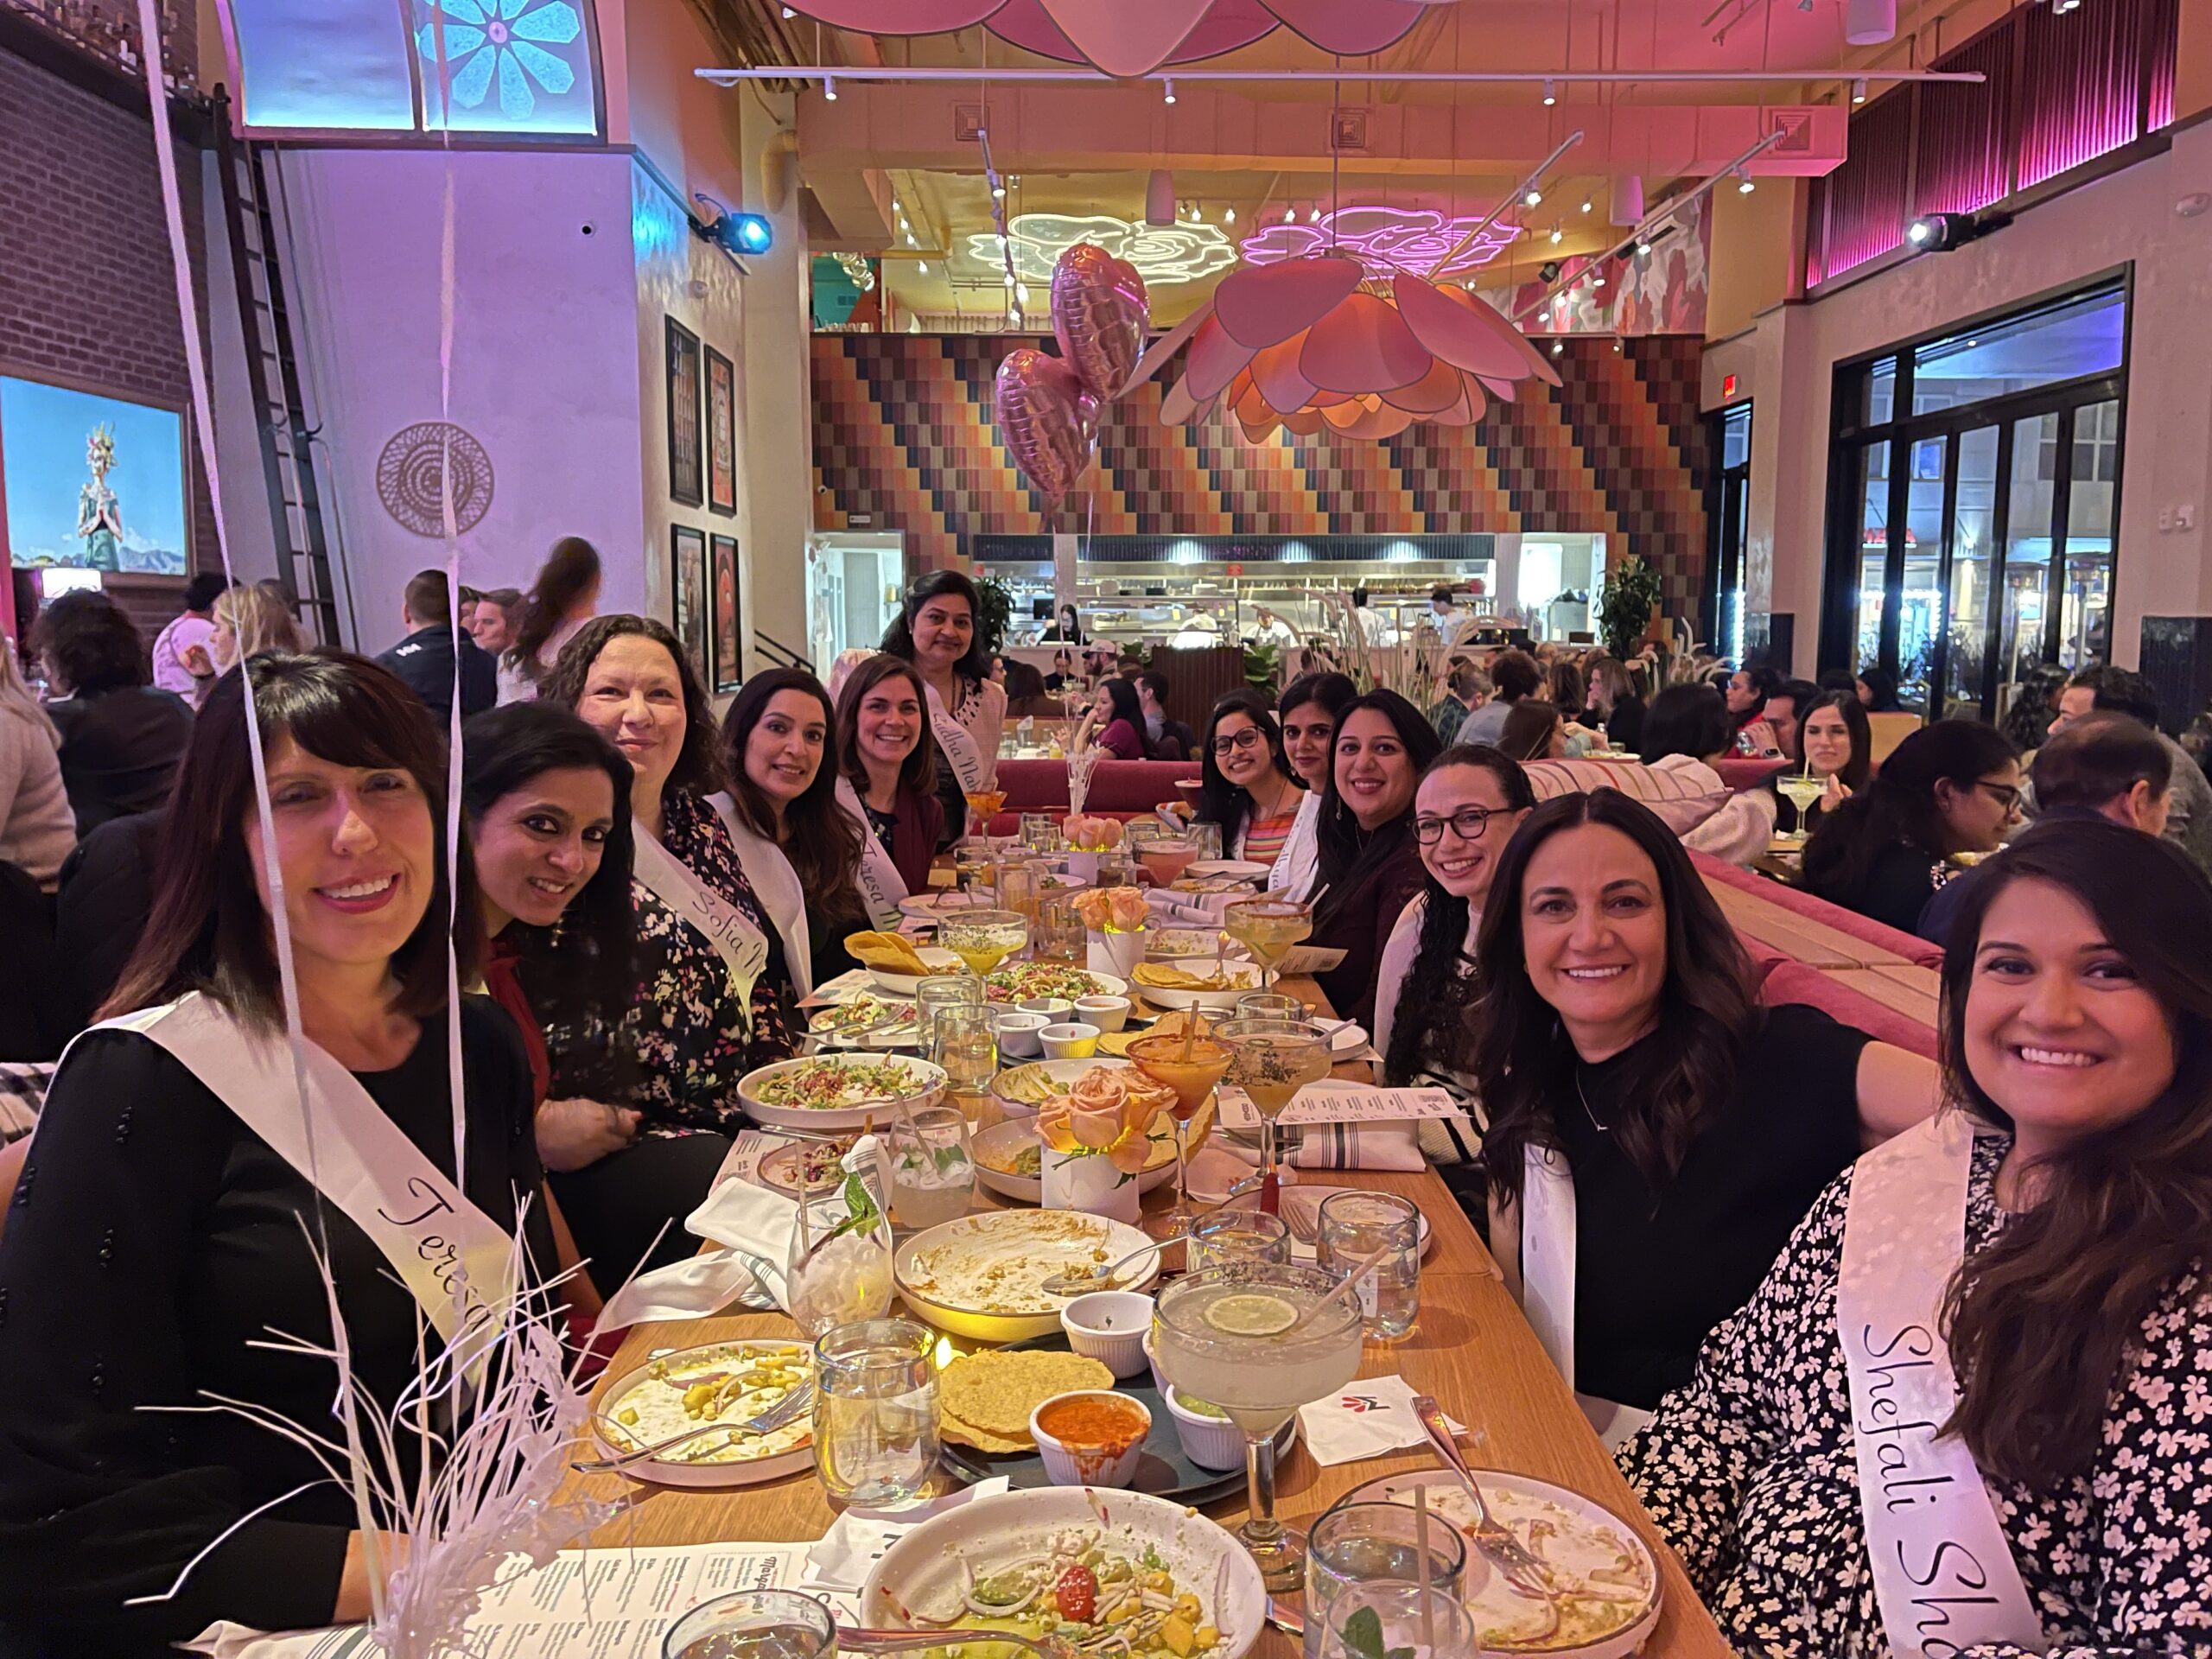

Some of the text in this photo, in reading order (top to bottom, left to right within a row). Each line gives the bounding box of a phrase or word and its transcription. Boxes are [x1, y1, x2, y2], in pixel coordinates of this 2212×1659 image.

[933, 713, 964, 758] Sudha
[692, 892, 743, 954] Sofia
[1859, 1323, 1955, 1515] Shefali
